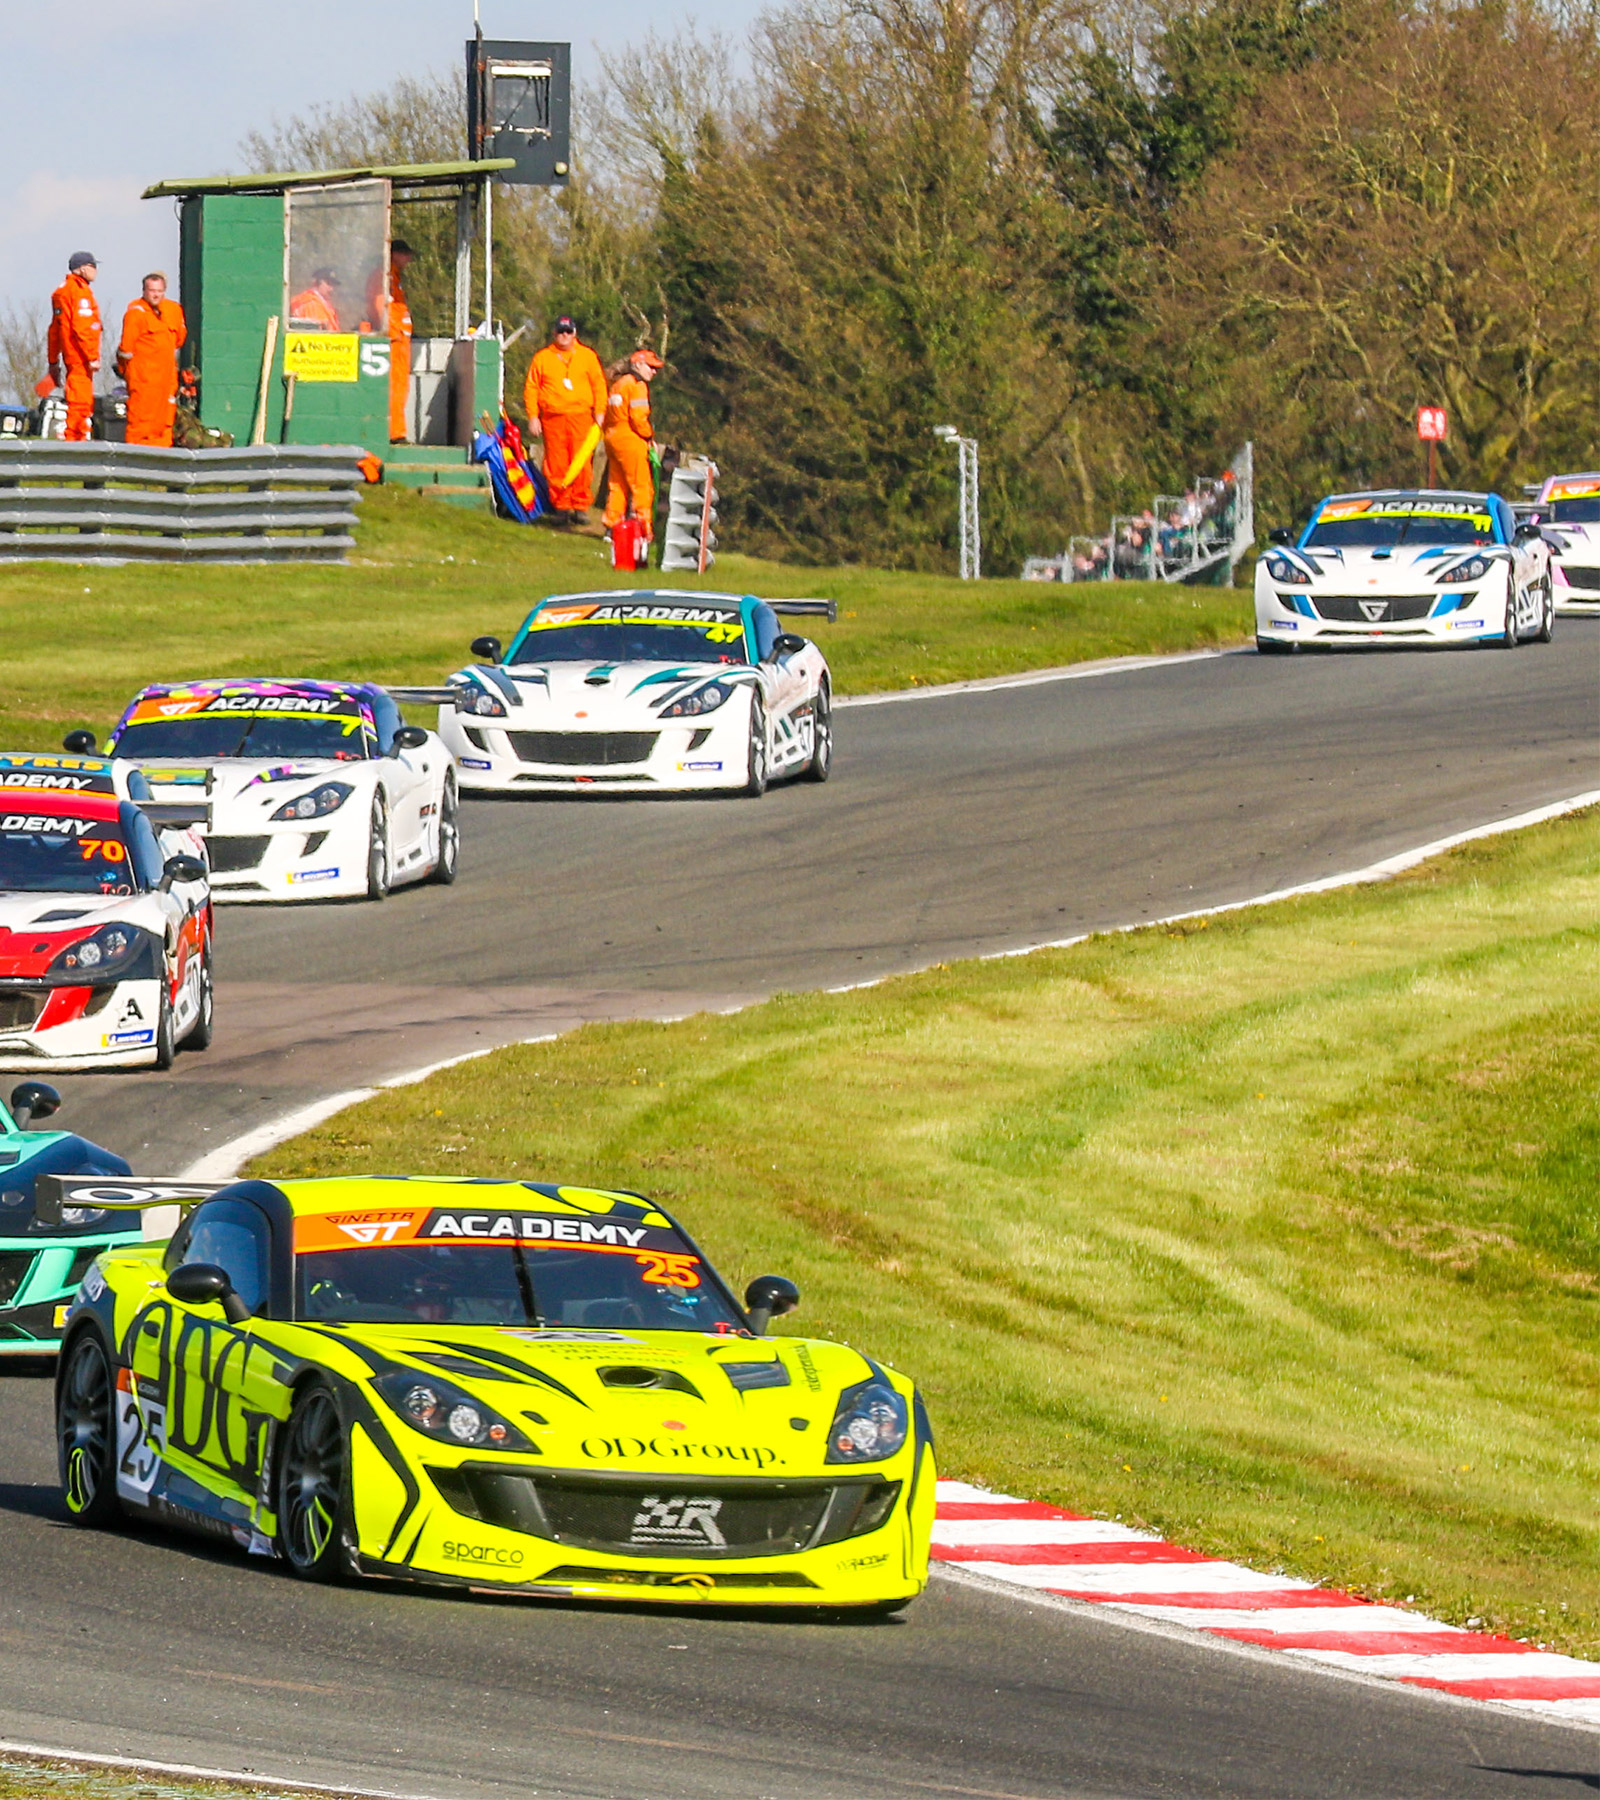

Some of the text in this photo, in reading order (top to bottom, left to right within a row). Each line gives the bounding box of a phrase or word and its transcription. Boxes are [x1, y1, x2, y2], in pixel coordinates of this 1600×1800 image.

[361, 343, 390, 377] 5
[1367, 501, 1483, 516] ACADEMY
[590, 605, 736, 624] ACADEMY
[704, 625, 744, 643] 47
[207, 696, 340, 713] ACADEMY
[339, 716, 363, 737] 7
[77, 838, 126, 863] 70
[325, 1211, 415, 1225] GINETTA
[337, 1214, 648, 1248] GT ACADEMY
[635, 1254, 701, 1289] 25
[120, 1401, 163, 1482] 25
[580, 1436, 787, 1469] ODGroup.
[442, 1539, 525, 1564] sparco
